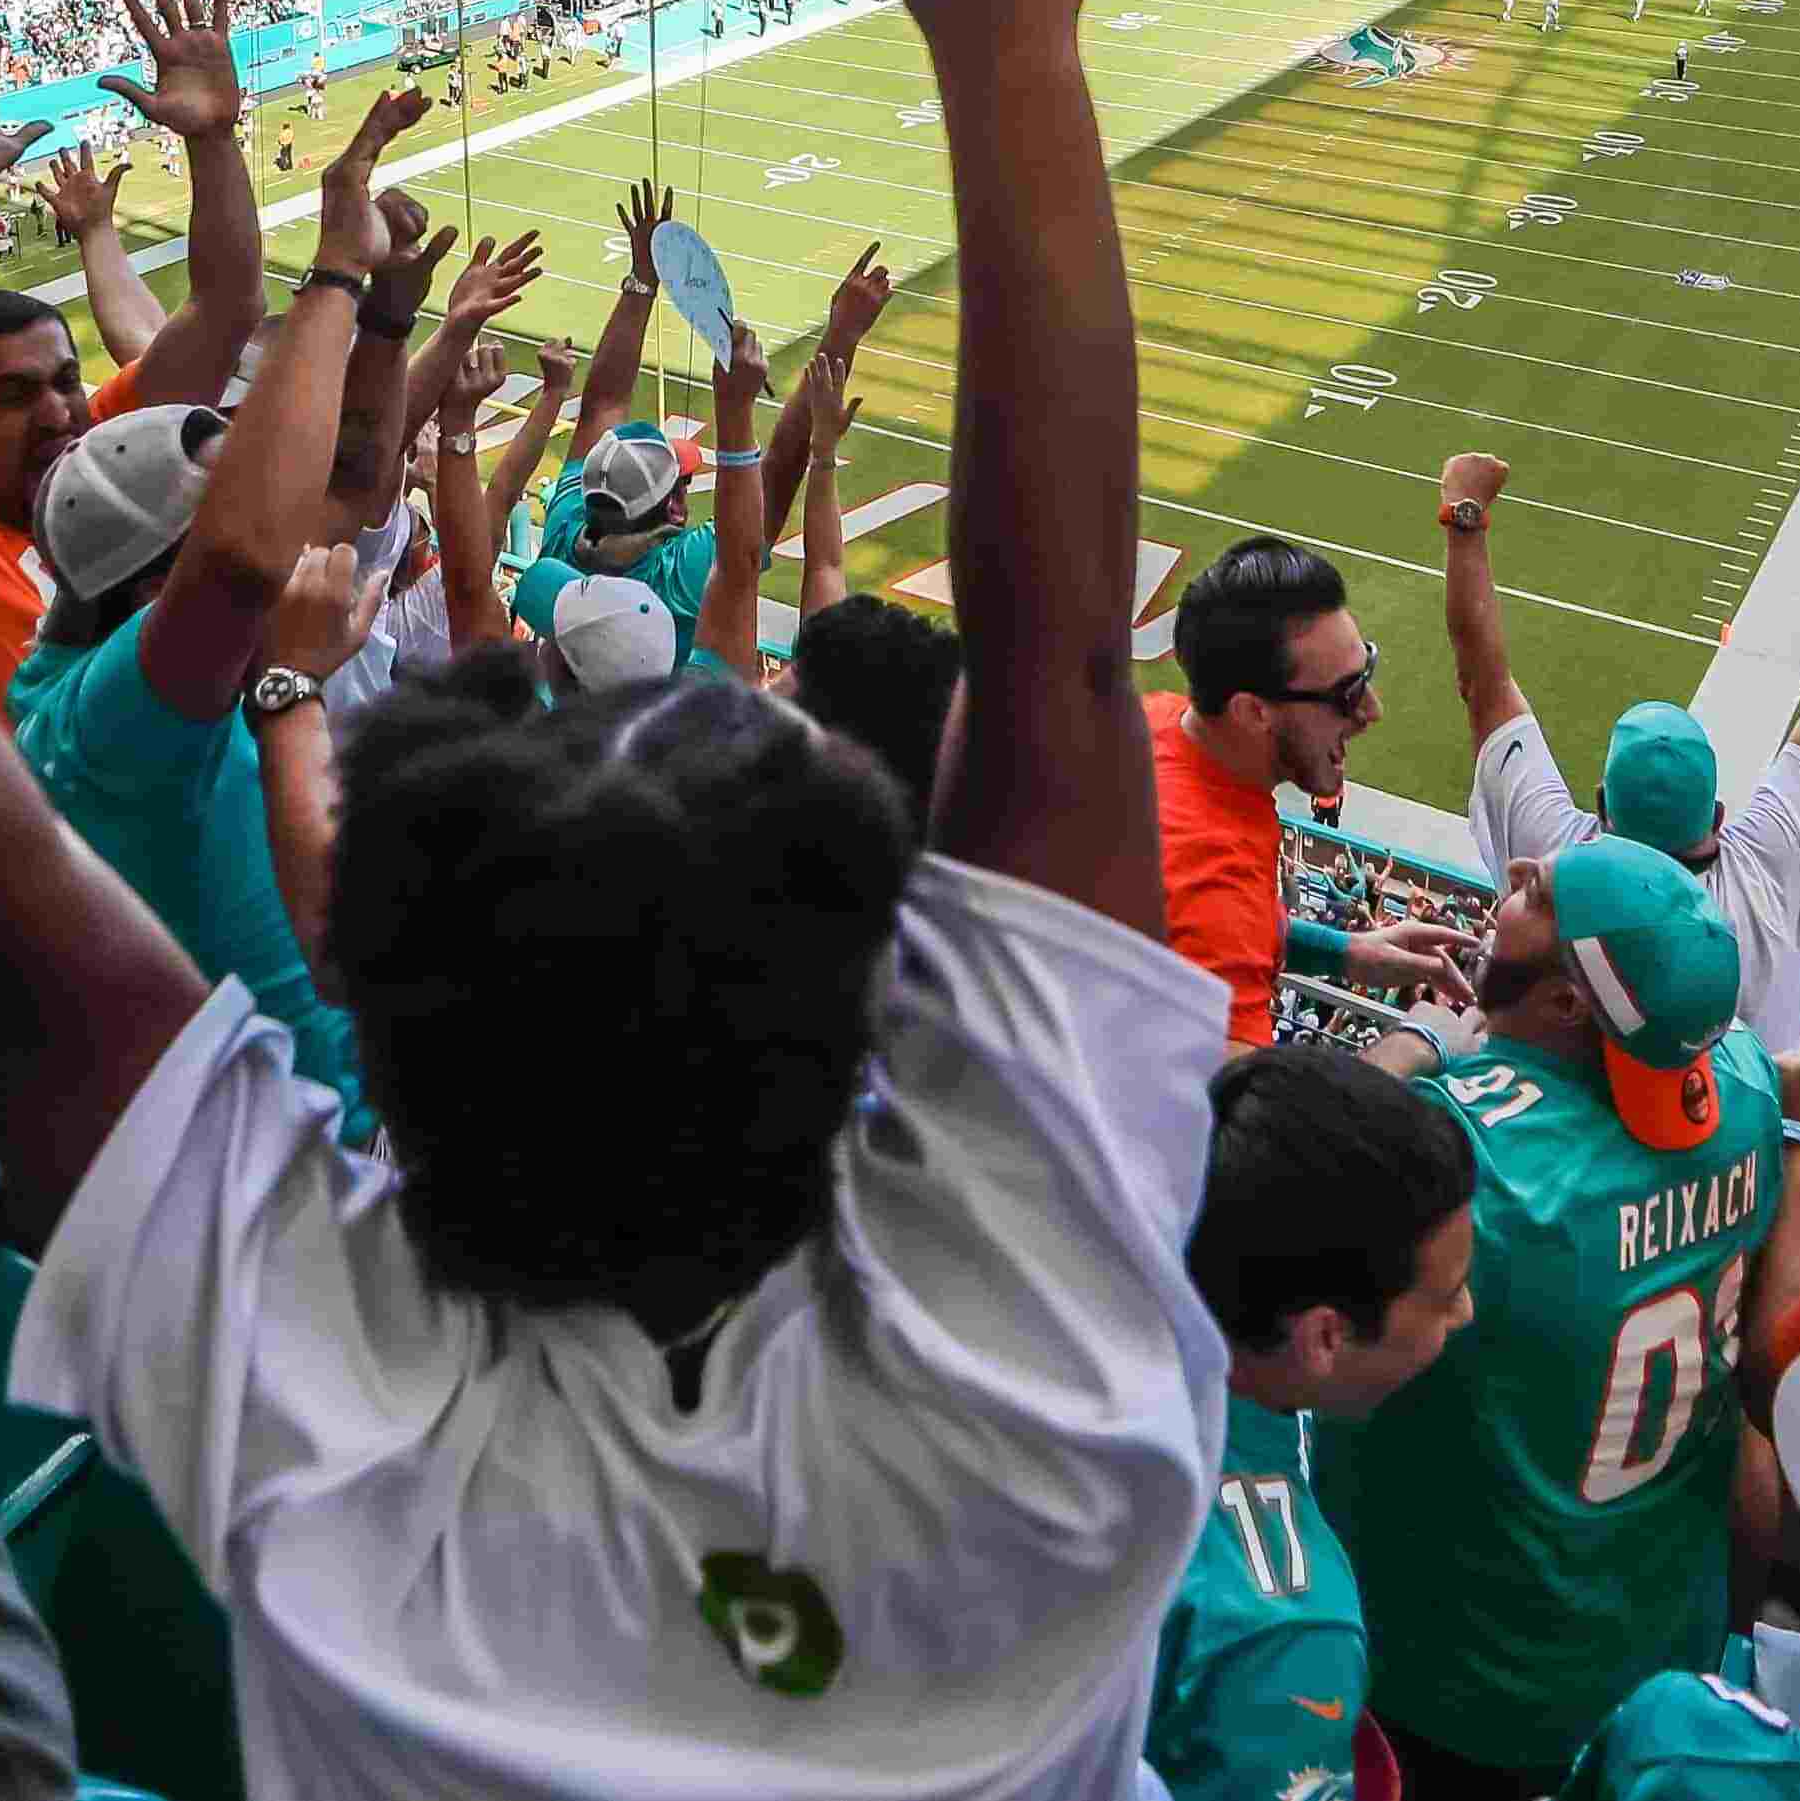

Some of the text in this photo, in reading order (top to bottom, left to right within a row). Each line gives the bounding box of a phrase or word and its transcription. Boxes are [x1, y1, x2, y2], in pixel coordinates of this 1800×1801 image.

[1584, 130, 1646, 159] 40
[1507, 193, 1579, 227] 30
[1418, 268, 1499, 312] 20
[1310, 363, 1398, 413] 10
[1618, 1150, 1758, 1272] REIXACH
[1220, 1479, 1308, 1594] 17
